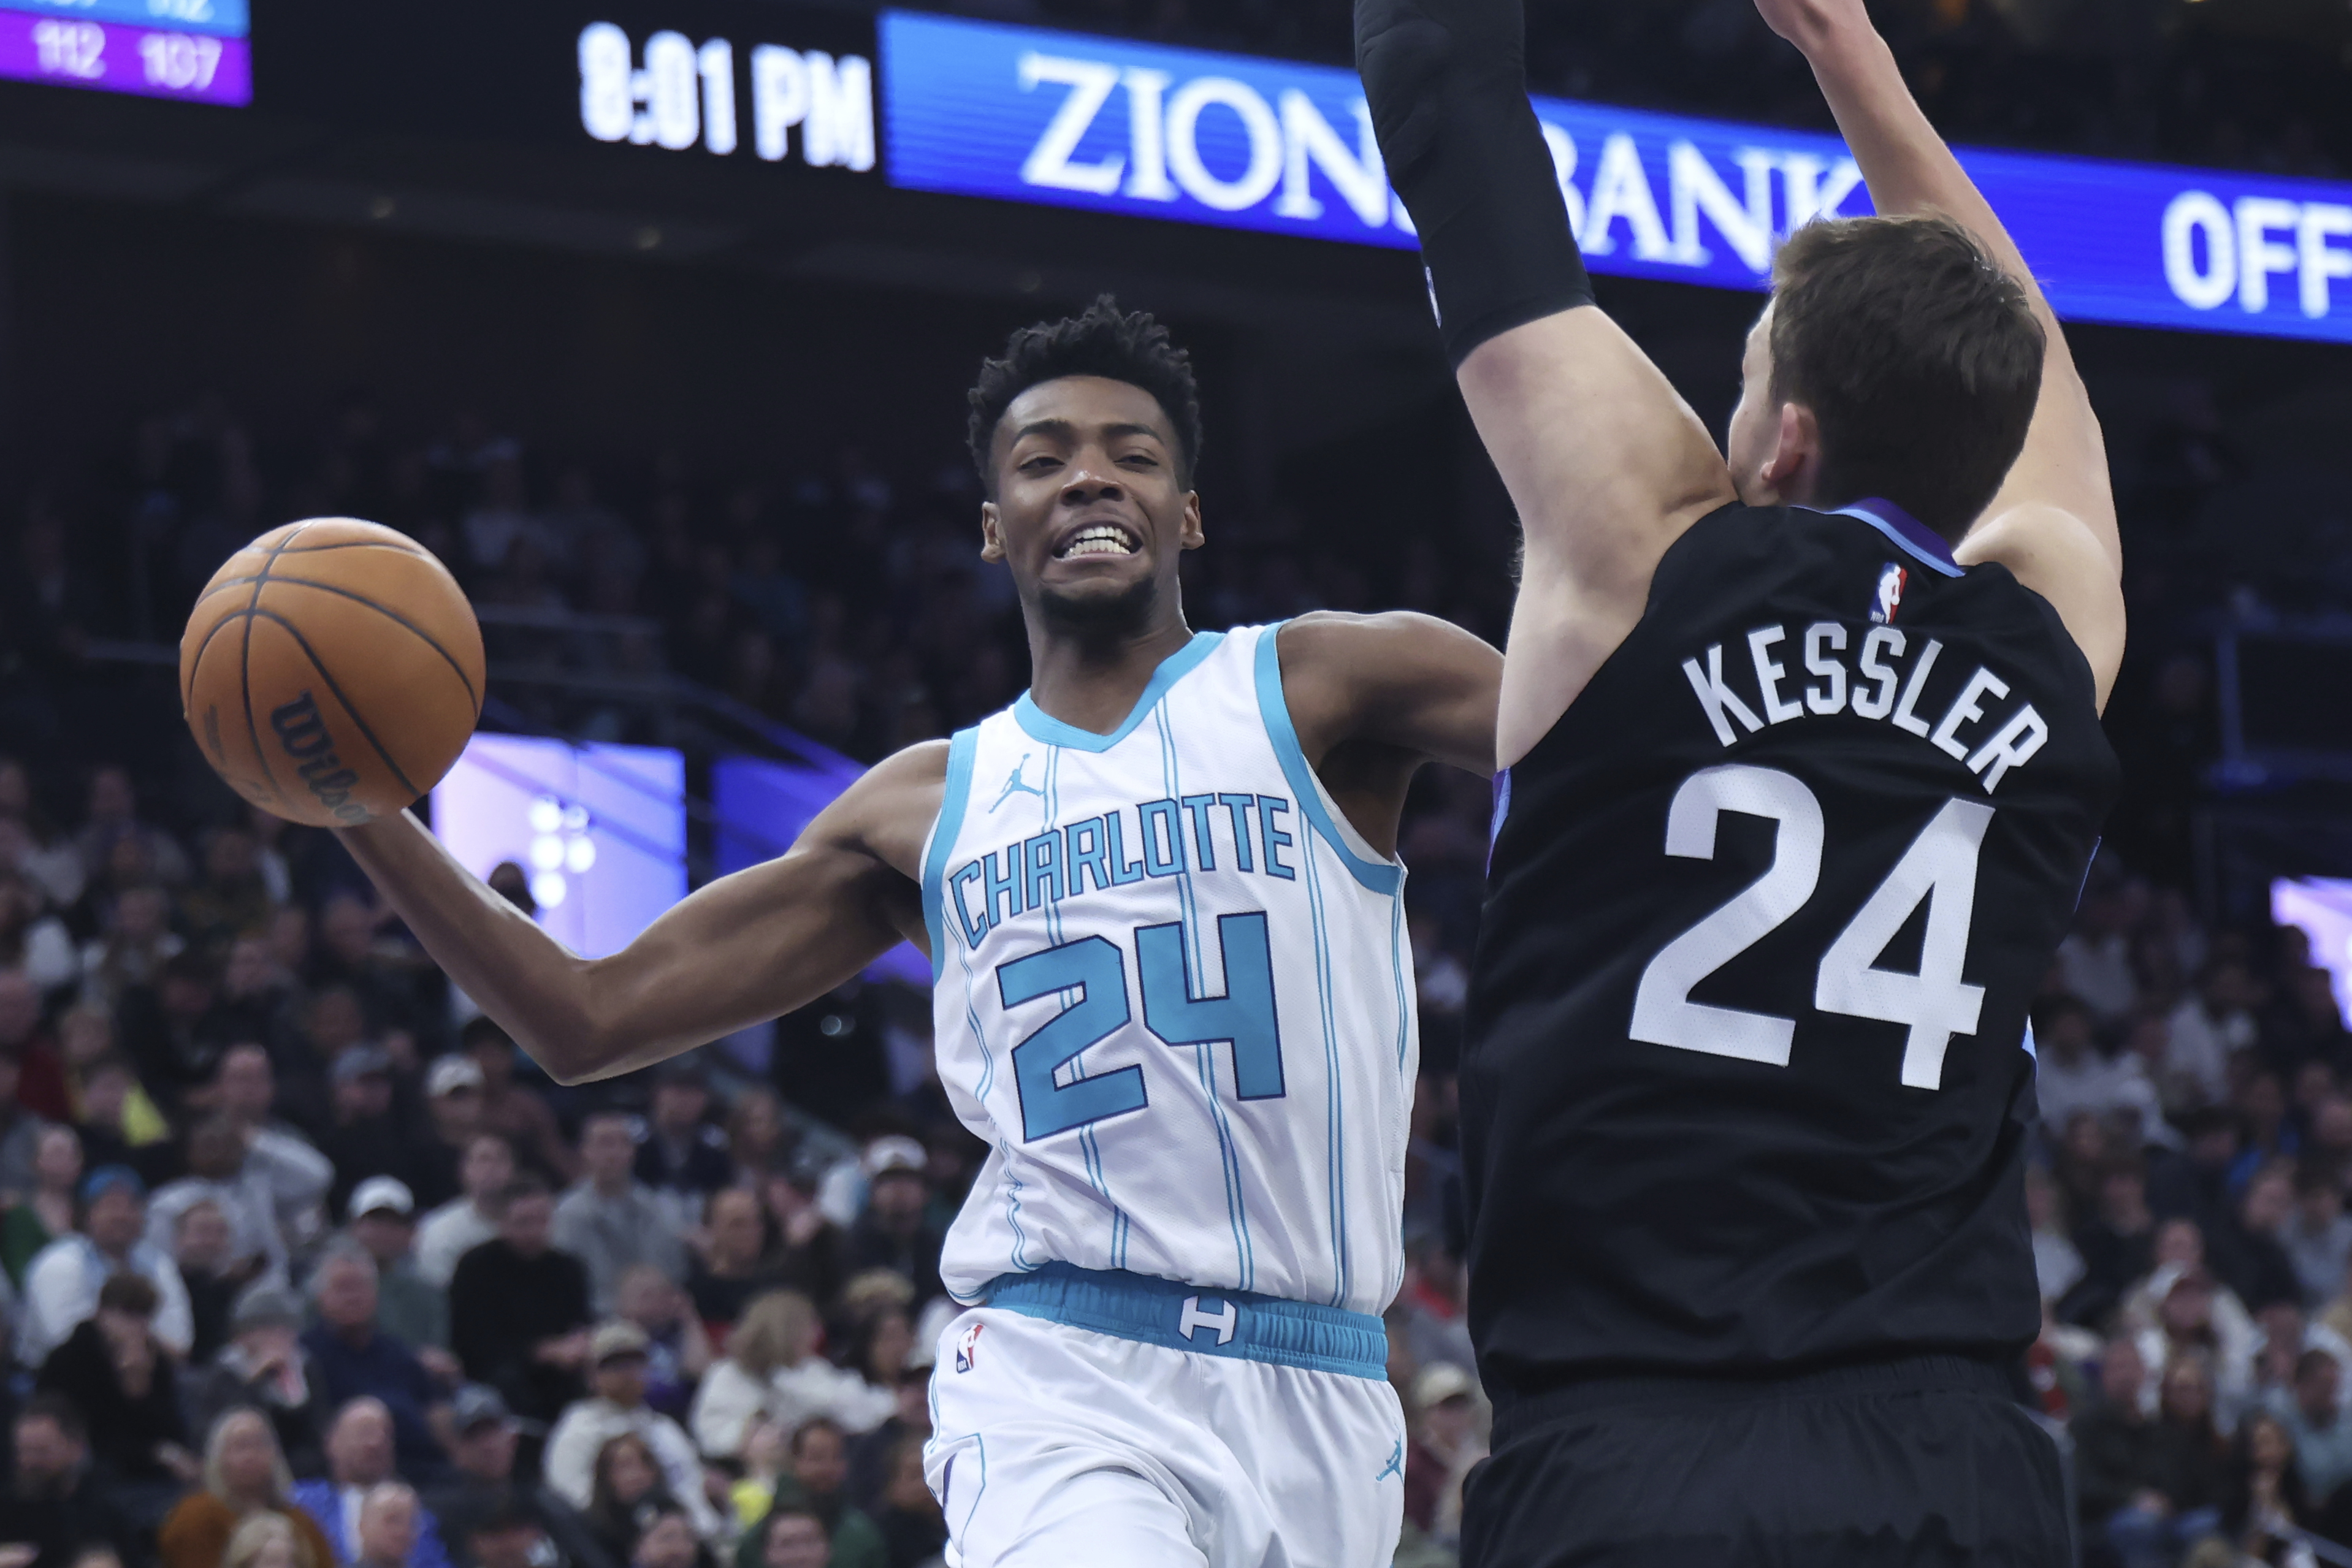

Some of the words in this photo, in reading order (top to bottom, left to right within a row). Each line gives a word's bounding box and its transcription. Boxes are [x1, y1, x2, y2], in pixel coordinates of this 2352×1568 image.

[577, 21, 737, 156] 8:01
[750, 43, 876, 173] PM
[1016, 50, 1418, 237] ZION
[271, 688, 374, 824] Wilso
[1682, 622, 2048, 795] KESSLER
[949, 793, 1296, 950] CHARLOTTE
[1628, 764, 1996, 1090] 24
[995, 910, 1286, 1143] 24
